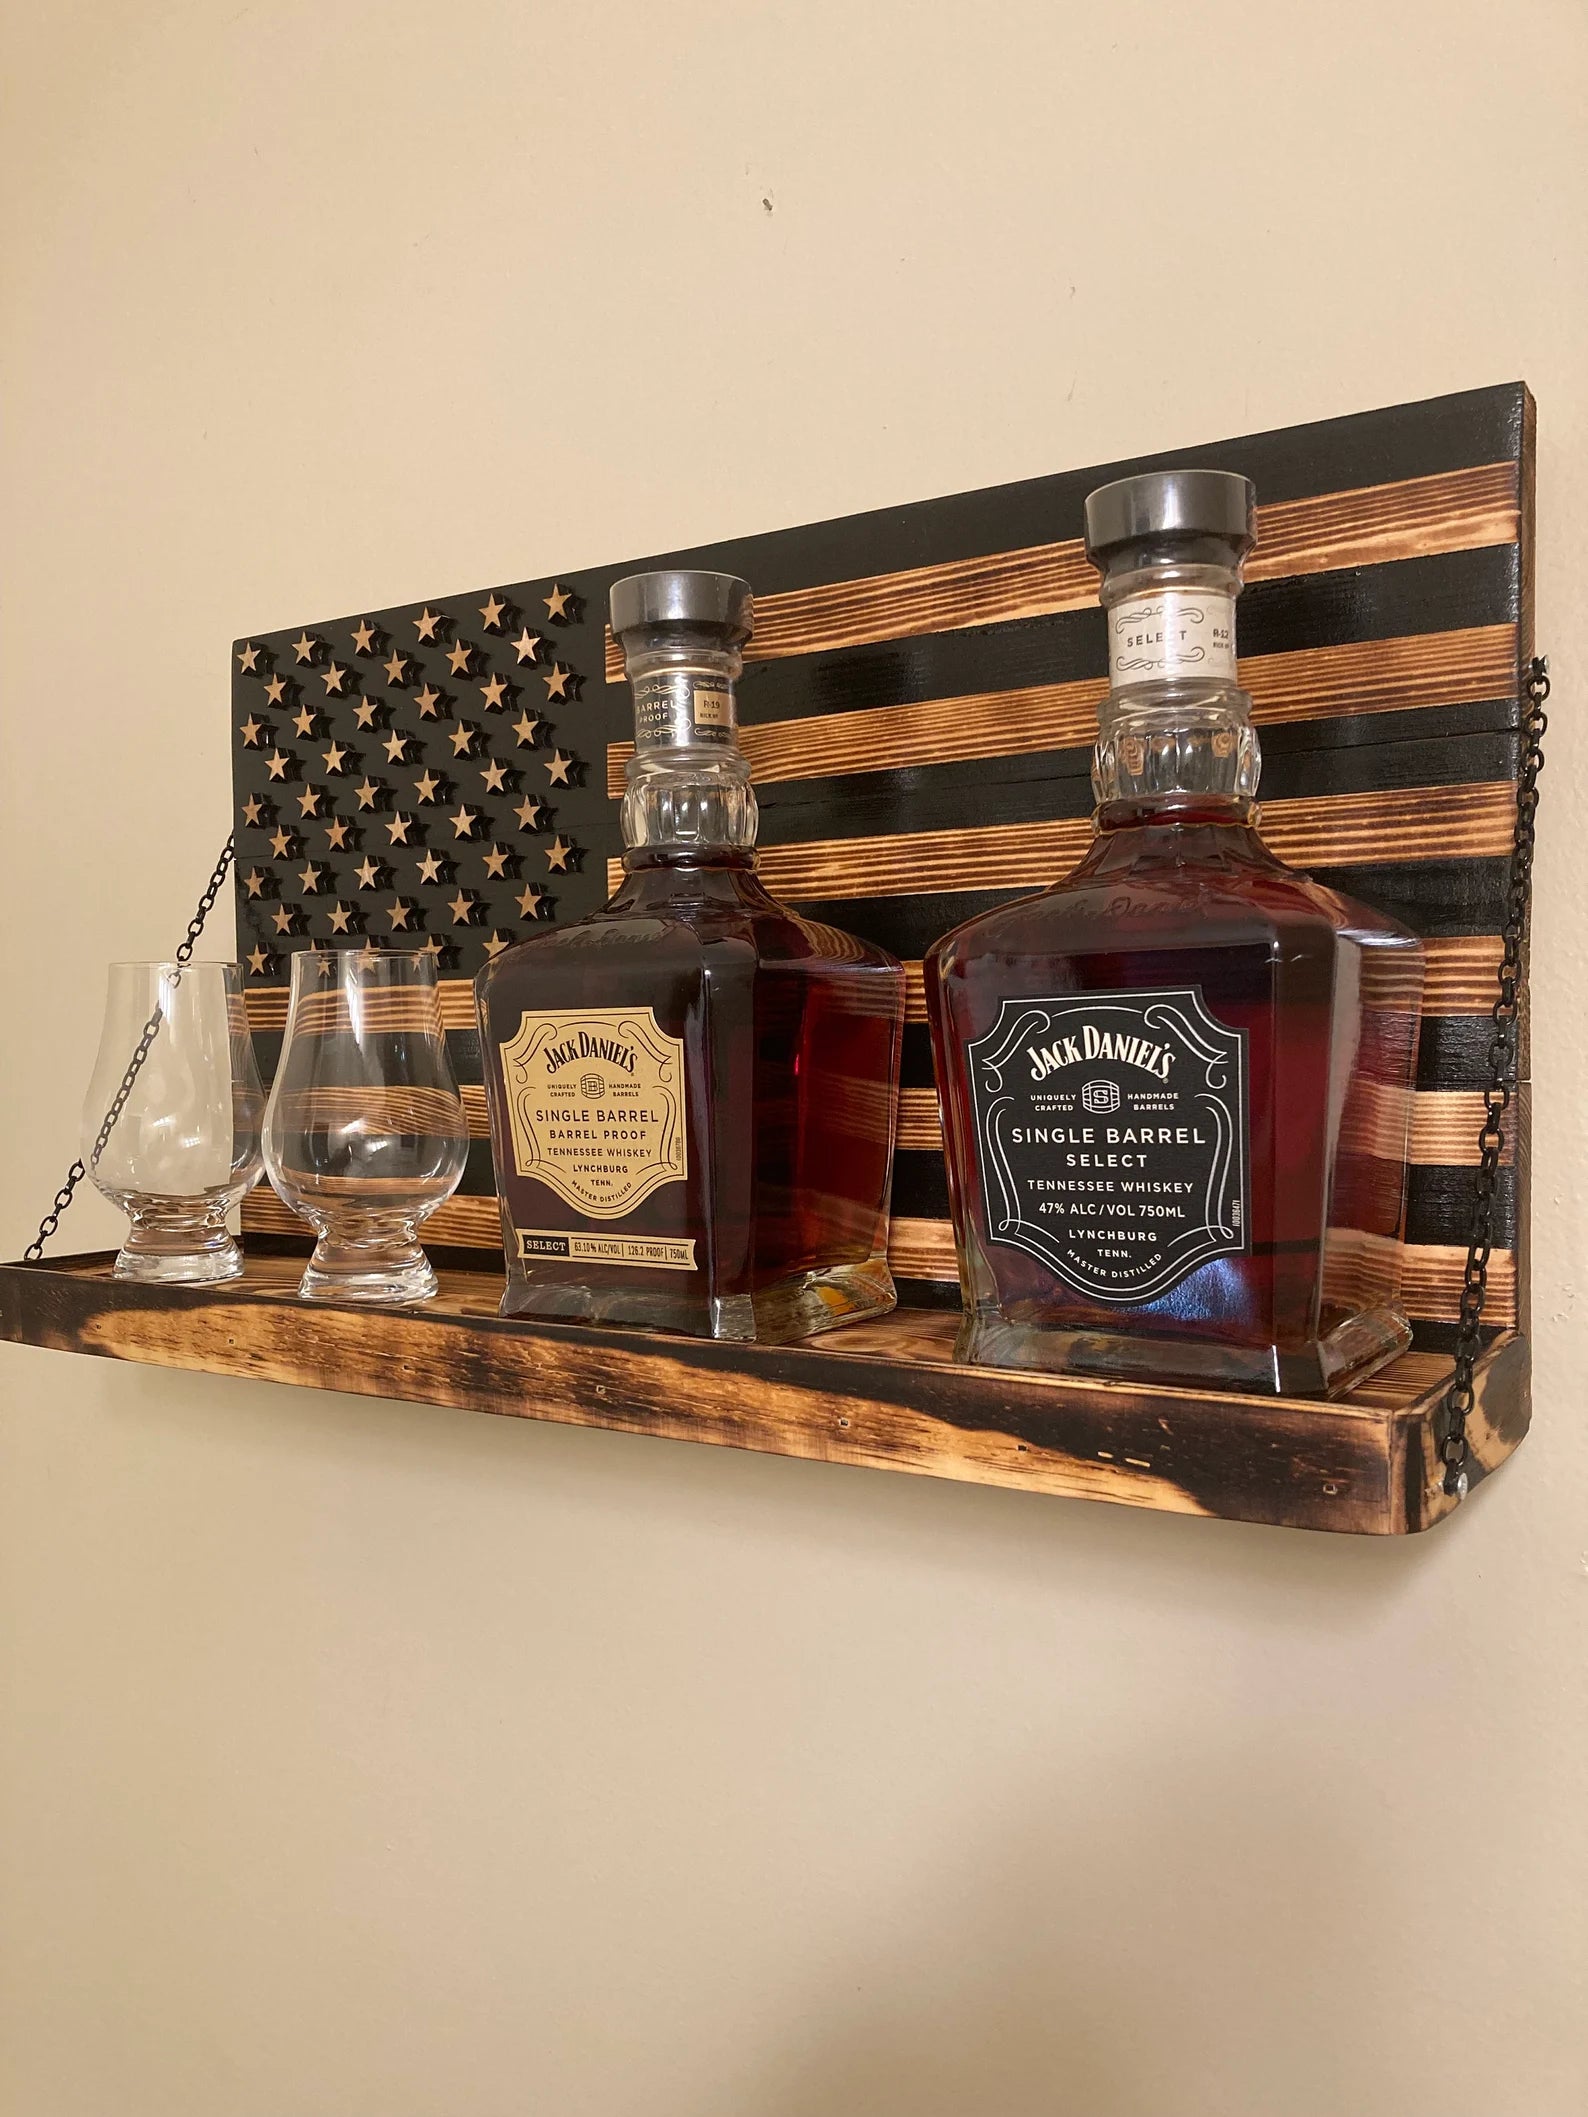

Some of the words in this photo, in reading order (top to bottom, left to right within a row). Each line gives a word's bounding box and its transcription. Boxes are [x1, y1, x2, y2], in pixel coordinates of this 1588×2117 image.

[1127, 630, 1187, 647] SELET
[543, 1039, 580, 1074] JACK
[578, 1031, 638, 1073] DANIEL'S
[1026, 1034, 1083, 1081] JACK
[1082, 1025, 1176, 1079] DANIEL'S
[1127, 1092, 1179, 1100] HANDMADE
[1133, 1103, 1175, 1111] BARRELS
[536, 1110, 590, 1122] SINGLE
[597, 1110, 659, 1122] BARREL
[549, 1129, 598, 1140] BARREL
[603, 1130, 647, 1140] PROOF
[1012, 1128, 1095, 1144] SINGLE
[1106, 1128, 1206, 1144] BARREL
[547, 1148, 603, 1157] TENNESSEE
[607, 1148, 652, 1158] WHISKEY
[1066, 1154, 1148, 1168] SELECT
[573, 1164, 628, 1174] LYNCHBURG
[590, 1179, 613, 1187] TENN.
[1027, 1180, 1115, 1192] TENNESSEE
[1121, 1182, 1194, 1194] WHISKEY
[572, 1180, 598, 1202] MASTER
[600, 1182, 632, 1203] DISTILLED
[1039, 1203, 1065, 1214] 47%
[1139, 1205, 1185, 1218] 750ML
[1069, 1229, 1157, 1242] LYNCHBURG
[526, 1240, 566, 1251] SELECT
[628, 1246, 644, 1256] 126.2
[646, 1246, 664, 1257] PROOF
[670, 1249, 689, 1260] 750ML
[1097, 1249, 1132, 1258] TENN.
[1066, 1249, 1106, 1277] MASTER
[1111, 1252, 1162, 1278] DISTILLED
